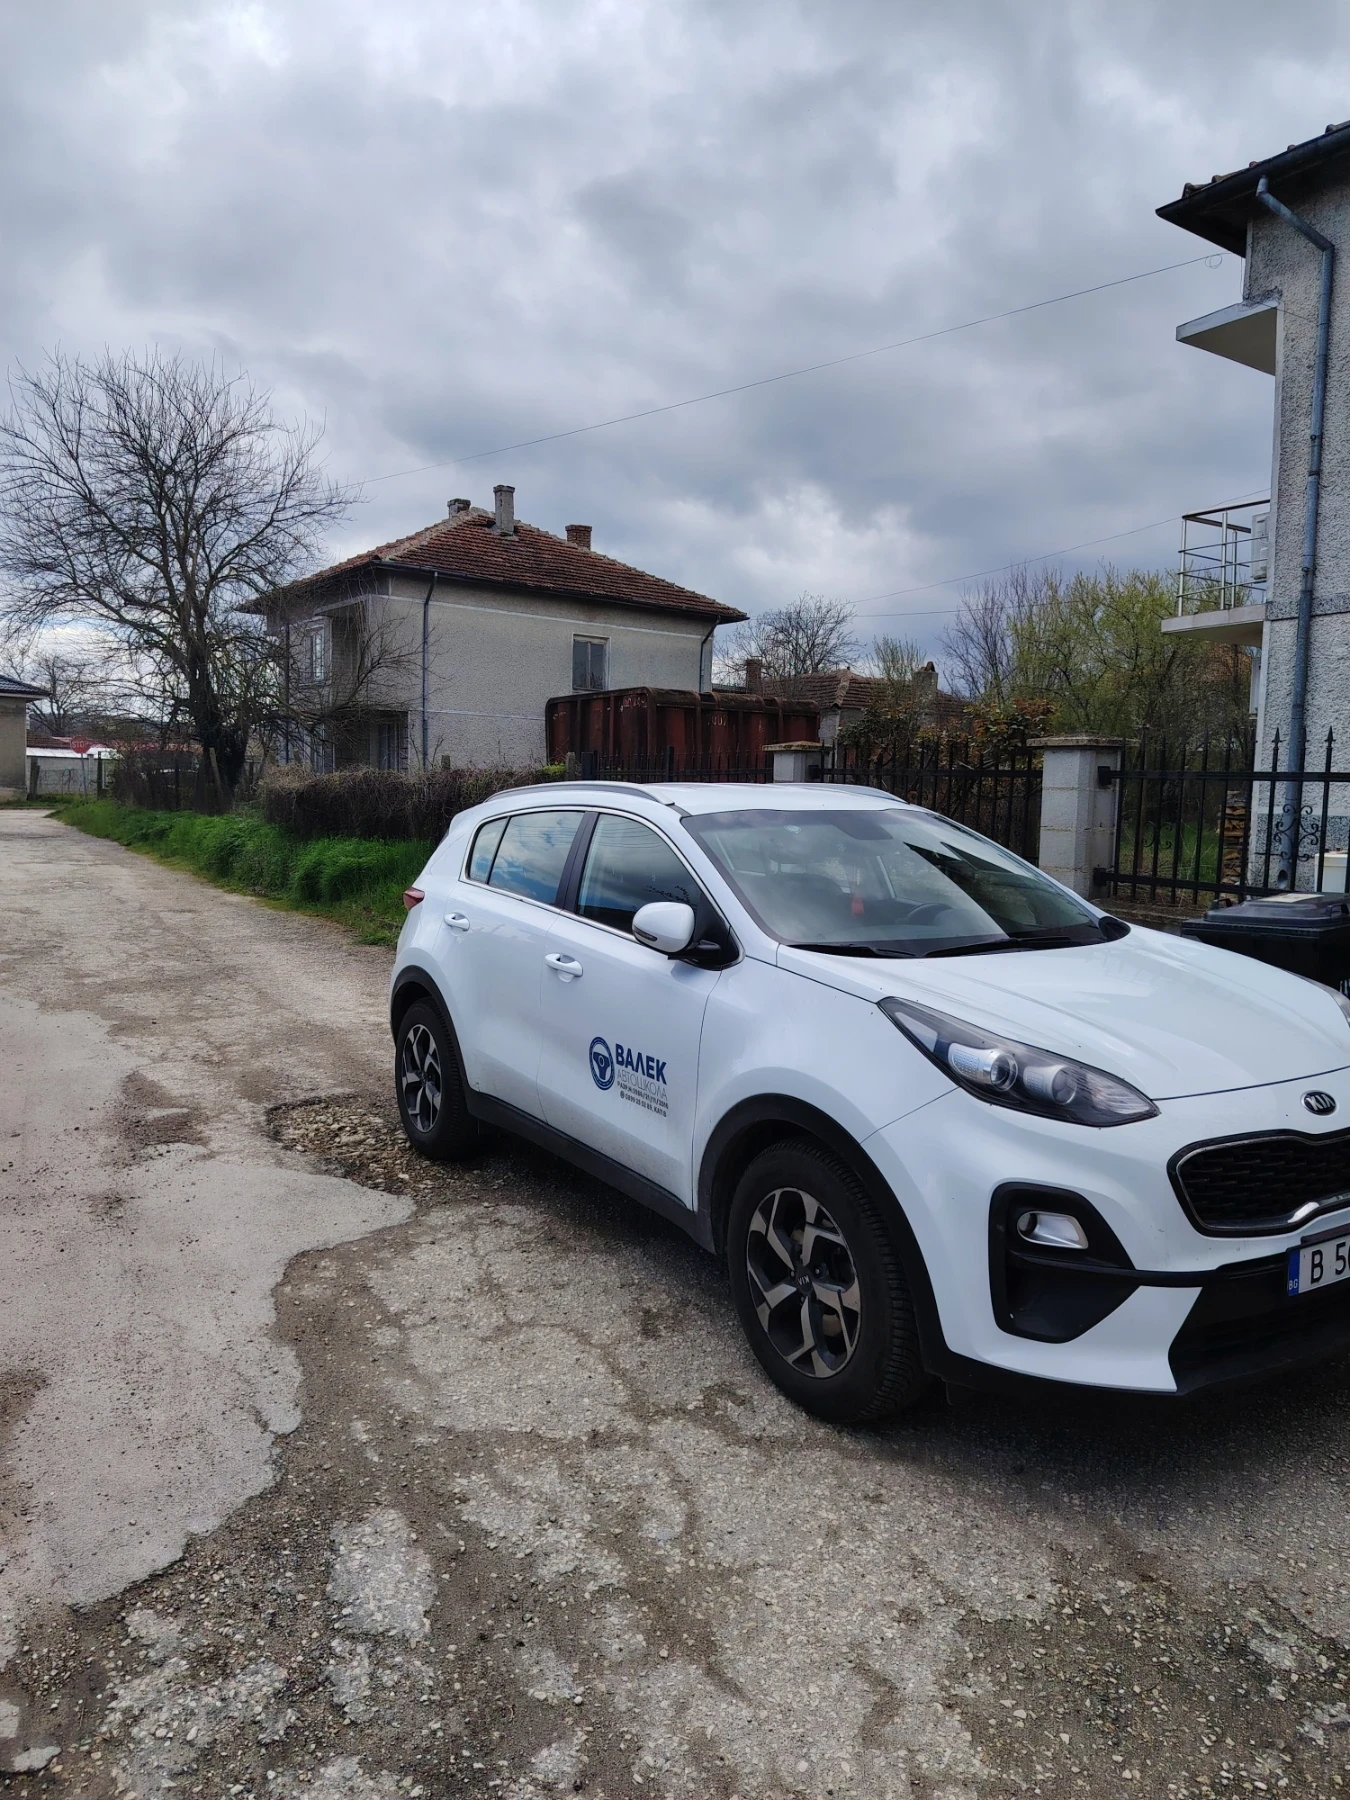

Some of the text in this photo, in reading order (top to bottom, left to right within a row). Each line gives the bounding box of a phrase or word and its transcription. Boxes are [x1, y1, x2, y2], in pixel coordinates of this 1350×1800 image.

[615, 1043, 667, 1085] ВАЛЕК
[617, 1069, 668, 1101] АВТОШКОЛА
[1305, 1093, 1335, 1111] KIA
[1311, 1241, 1350, 1284] B 5
[1288, 1278, 1299, 1291] BG
